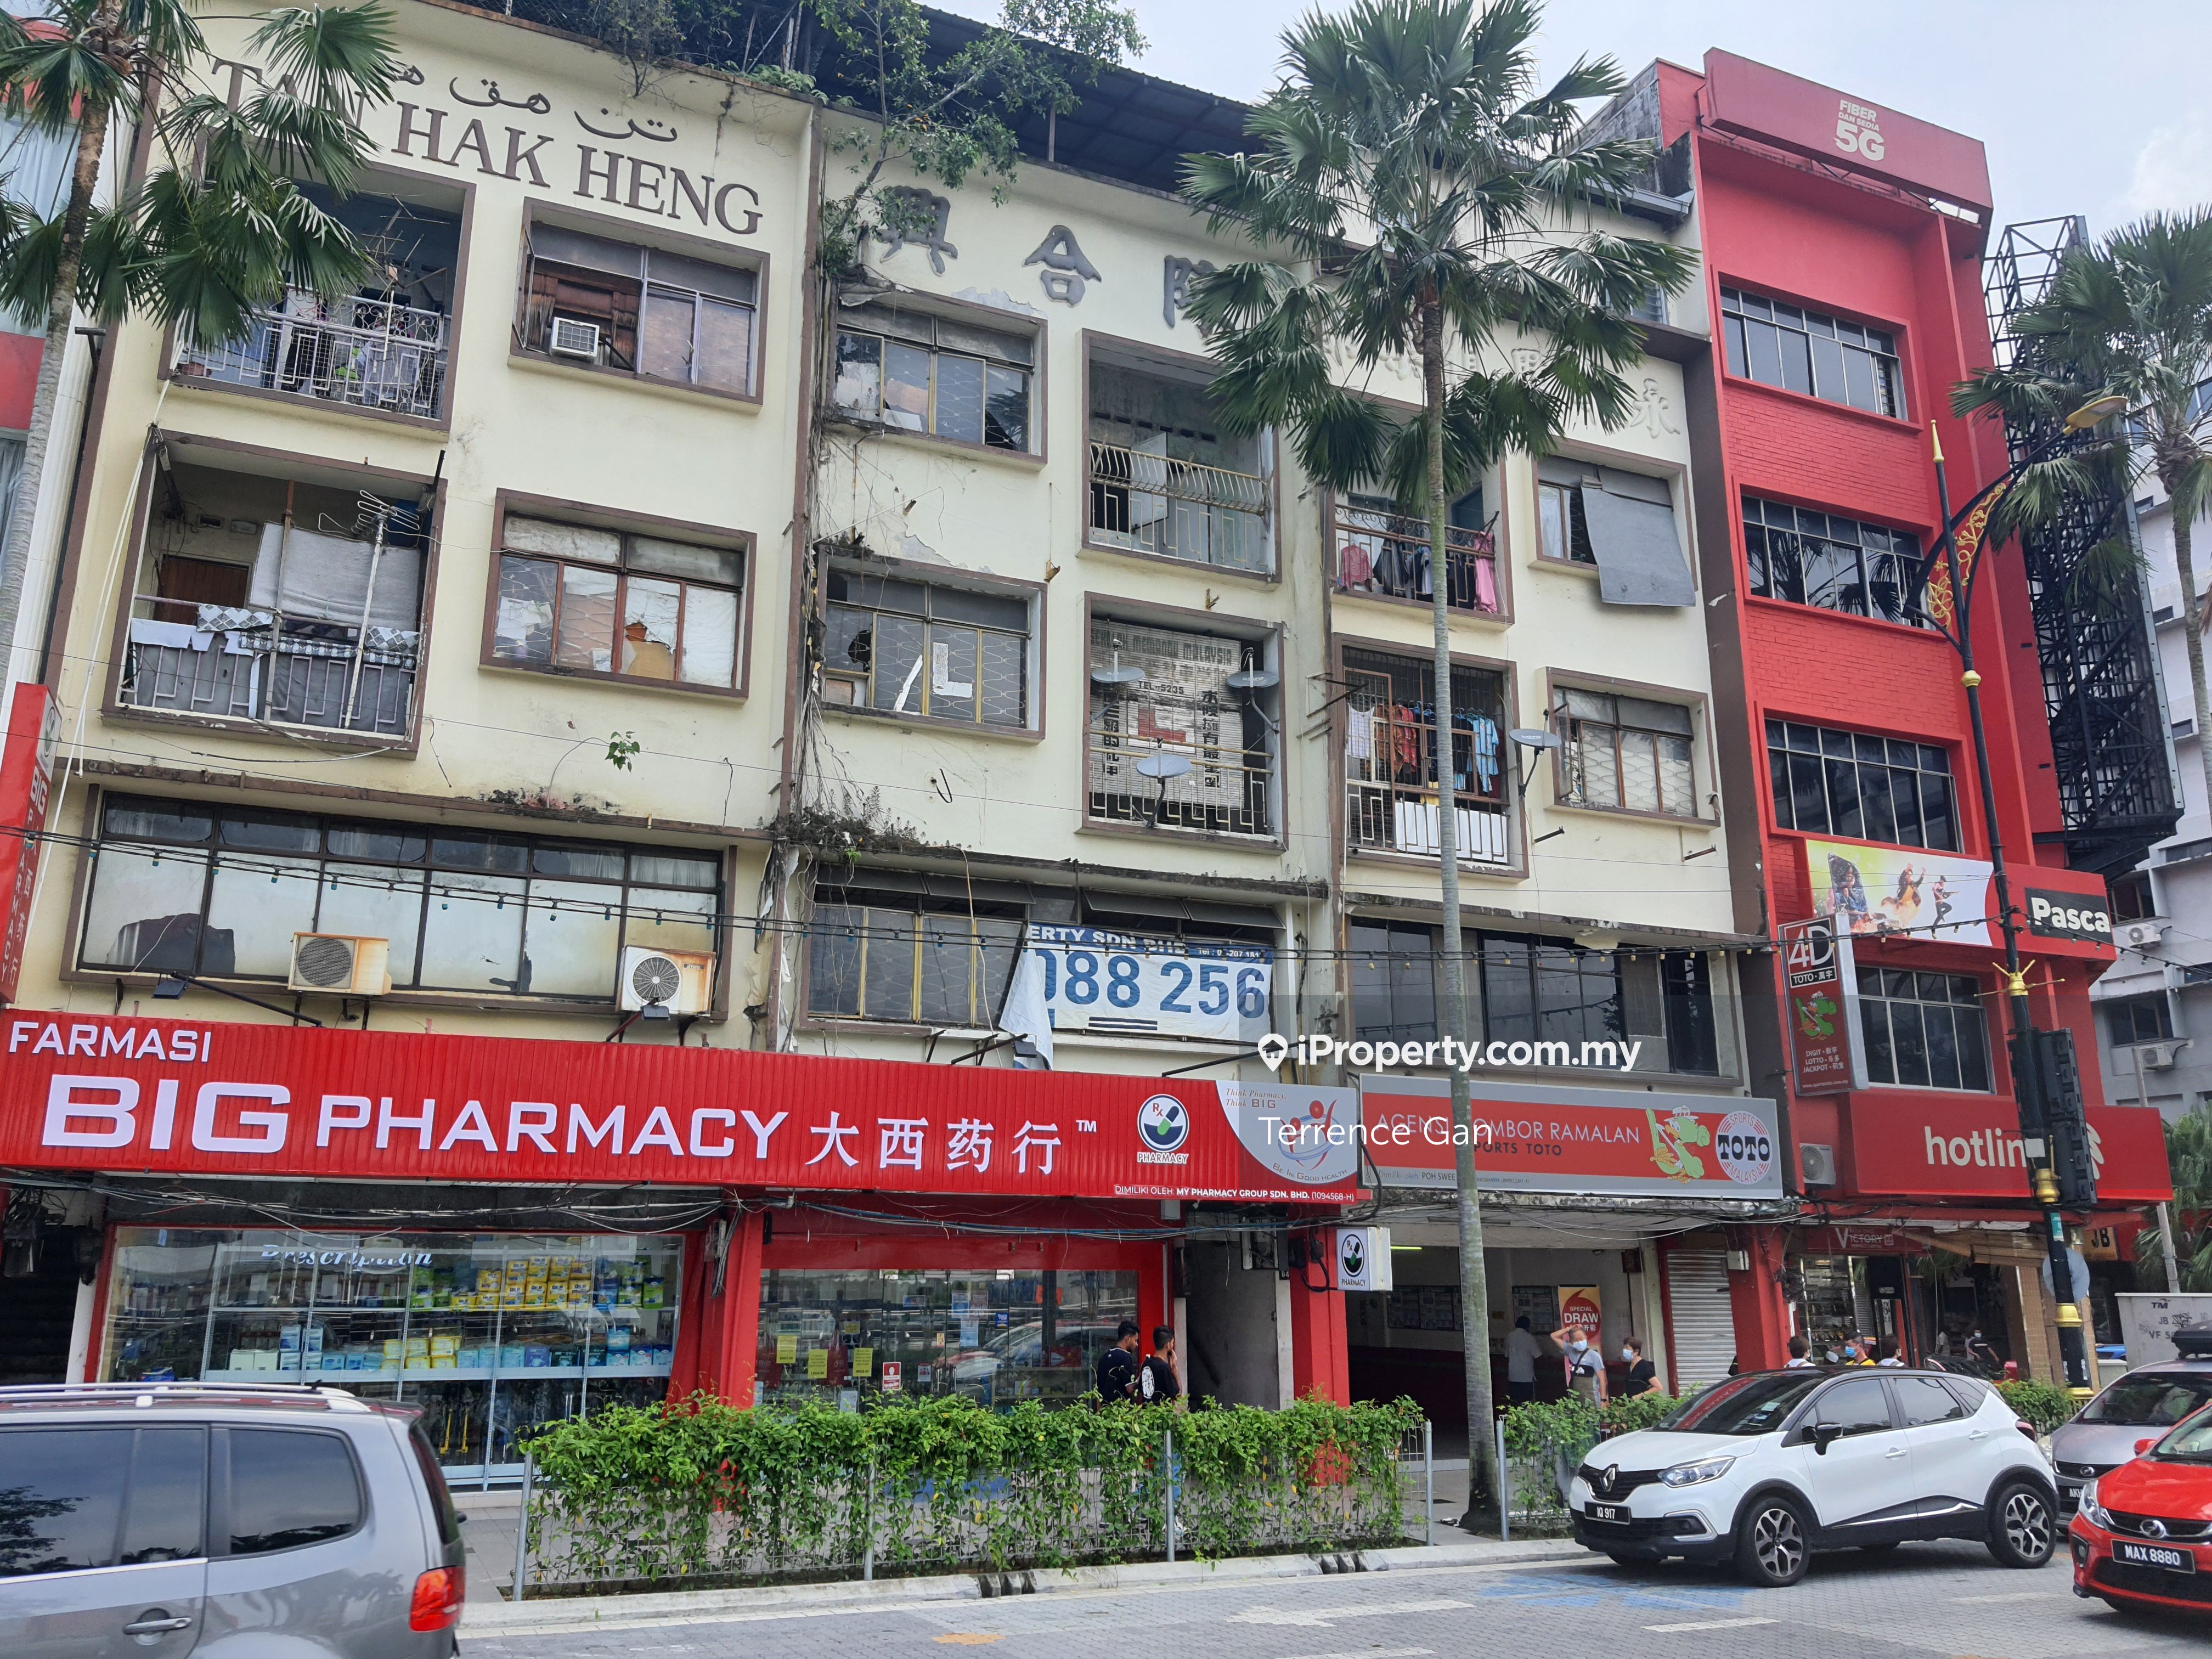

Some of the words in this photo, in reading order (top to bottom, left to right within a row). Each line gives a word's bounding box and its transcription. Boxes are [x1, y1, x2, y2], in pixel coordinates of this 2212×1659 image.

[1839, 99, 1877, 122] FIBER
[1838, 111, 1855, 123] DAN
[1856, 118, 1880, 132] SEDIA
[1833, 119, 1884, 161] 5G
[391, 101, 551, 188] HAK
[573, 144, 763, 235] HENG
[1183, 643, 1232, 665] MALAYSIA
[1139, 681, 1156, 691] TEL
[1160, 685, 1185, 695] 5235
[30, 765, 48, 816] BIG
[2031, 898, 2111, 933] Pasca
[1092, 932, 1137, 950] SDN
[1217, 949, 1244, 957] 0-207
[1789, 926, 1833, 967] 4D
[1793, 973, 1814, 984] TOTO
[1159, 961, 1265, 1019] 256
[8, 1020, 212, 1063] FARMASI
[1803, 1064, 1828, 1073] JACKPOT
[1226, 1088, 1246, 1097] Think
[1249, 1090, 1286, 1101] Pharmacy,
[1226, 1098, 1246, 1107] Think
[1252, 1099, 1276, 1108] BIG
[42, 1074, 291, 1153] BIG
[315, 1093, 789, 1159] PHARMACY
[1730, 1113, 1755, 1126] SPORTS
[1376, 1113, 1449, 1135] AGENSI
[1473, 1118, 1543, 1140] OMBOR
[1550, 1122, 1639, 1144] RAMALAN
[805, 1110, 1062, 1175] 大西药行
[1474, 1141, 1518, 1154] PORTS
[1526, 1143, 1562, 1156] TOTO
[1718, 1134, 1770, 1162] TOTO
[1924, 1126, 2027, 1168] hotlin
[1138, 1152, 1189, 1164] PHARMACY
[1378, 1170, 1402, 1179] Dimiliki
[1421, 1172, 1436, 1180] POH
[1437, 1172, 1455, 1181] SWEE
[1729, 1165, 1764, 1183] MALAYSIA
[1115, 1185, 1149, 1195] DIMILIKI
[1150, 1186, 1175, 1195] OLEH:
[1176, 1187, 1190, 1195] MY
[1192, 1188, 1238, 1198] PHARMACY
[1239, 1189, 1268, 1198] GROUP
[1270, 1190, 1289, 1199] SDN.
[1290, 1191, 1310, 1200] BHD.
[1311, 1192, 1354, 1202] (1094568-H)
[1835, 1227, 1883, 1249] VICTORY
[1341, 1278, 1366, 1286] PHARMACY
[1564, 1313, 1599, 1323] DRAW
[2159, 1317, 2169, 1325] JB
[1605, 1508, 1616, 1520] 917
[2124, 1545, 2148, 1562] MAX
[2149, 1549, 2181, 1566] 8880
